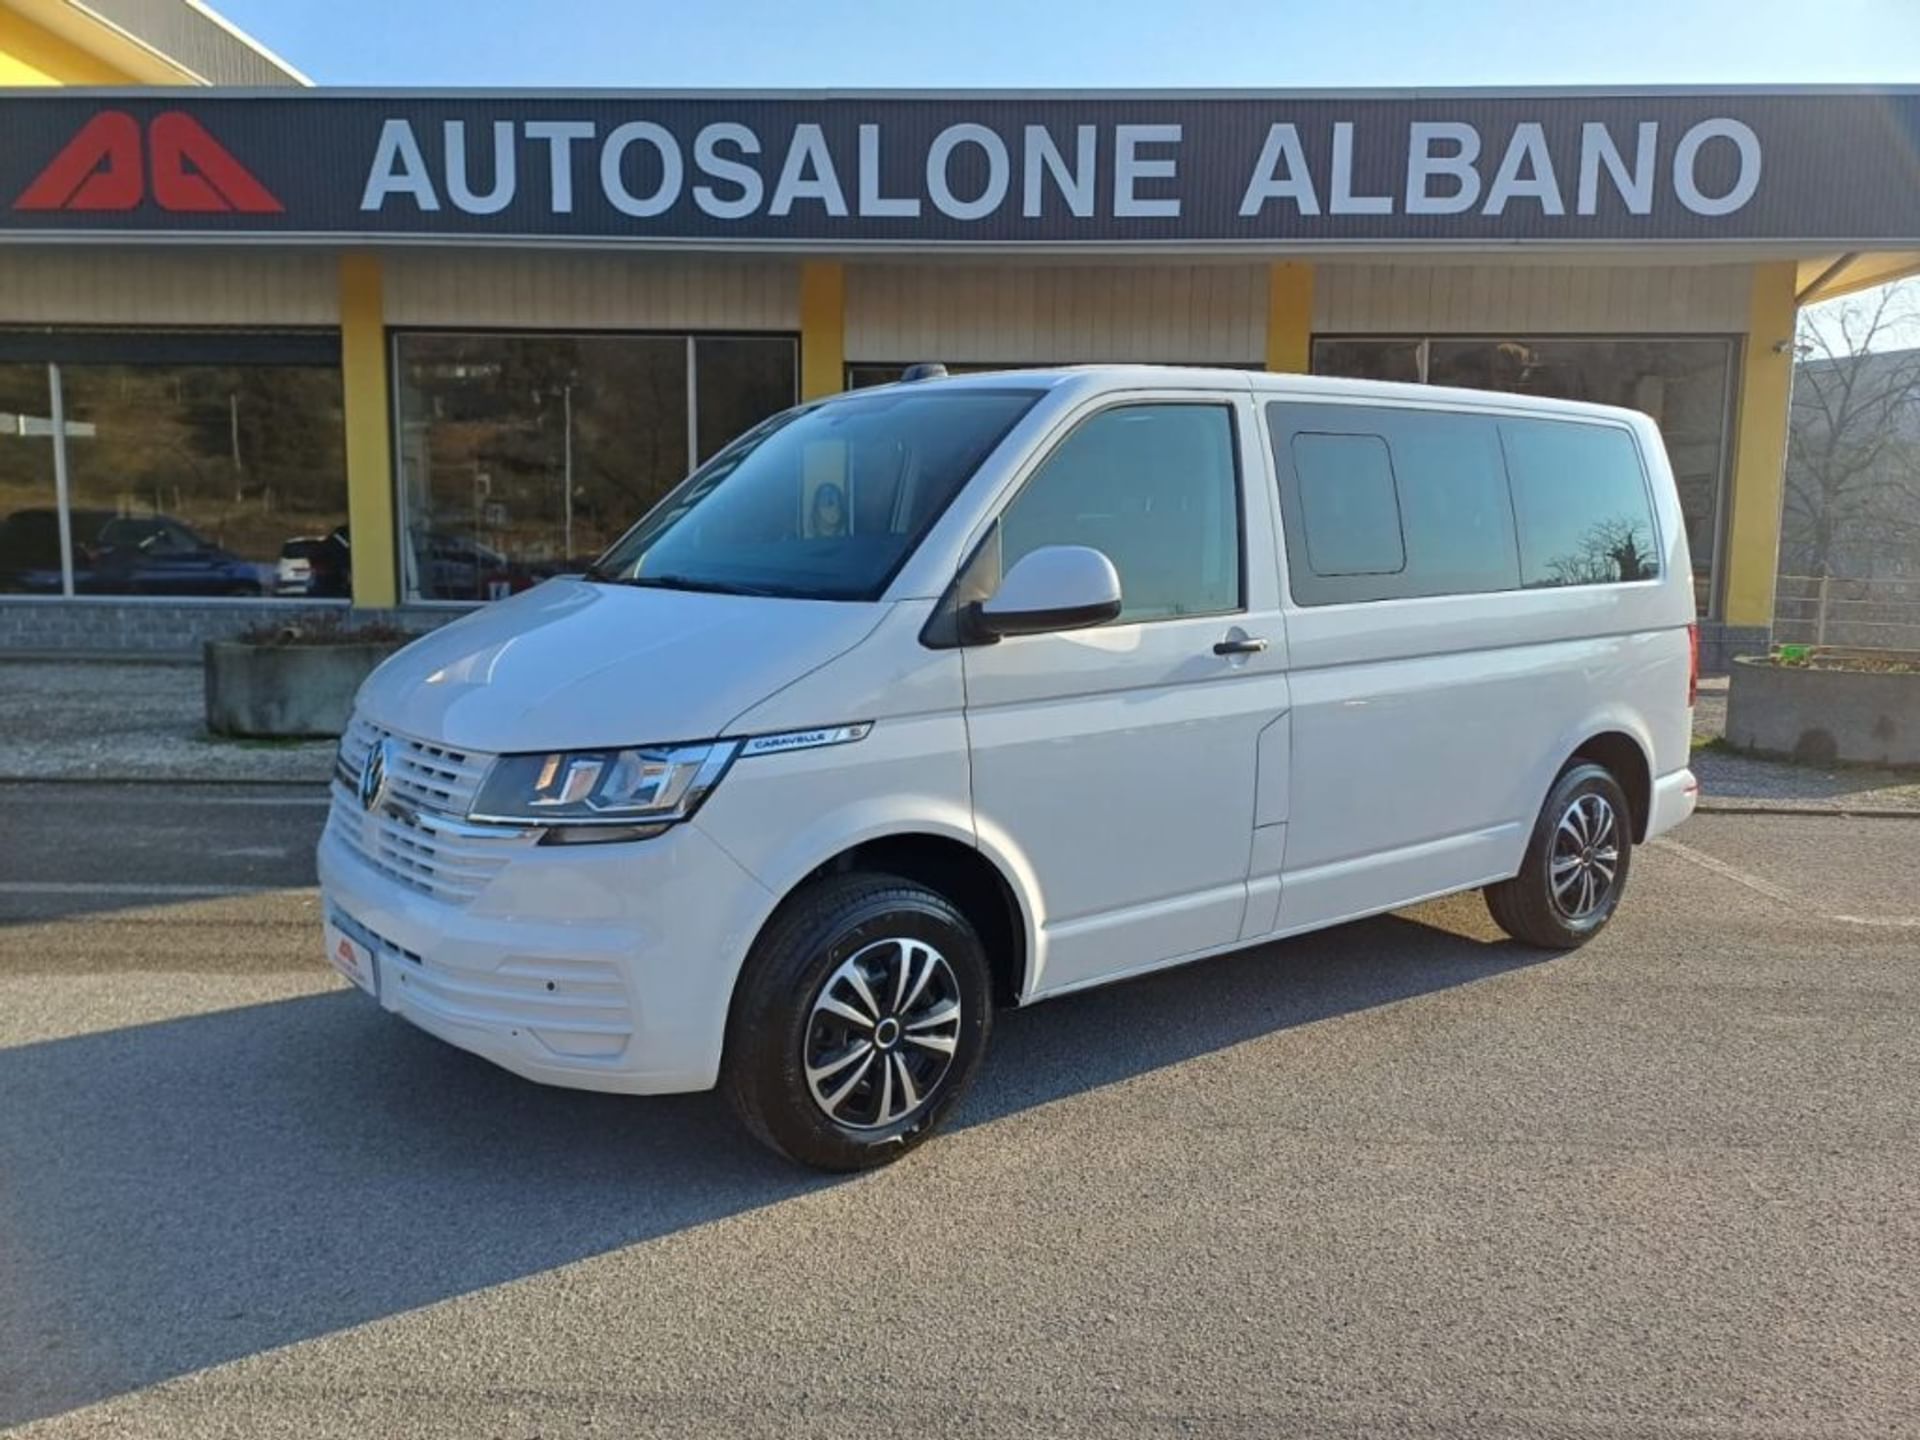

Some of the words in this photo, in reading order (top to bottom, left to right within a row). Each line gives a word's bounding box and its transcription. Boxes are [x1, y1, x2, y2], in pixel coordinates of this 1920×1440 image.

[360, 117, 1184, 220] AUTOSALONE
[1239, 117, 1763, 218] ALBANO
[754, 733, 826, 749] CARAVELLE
